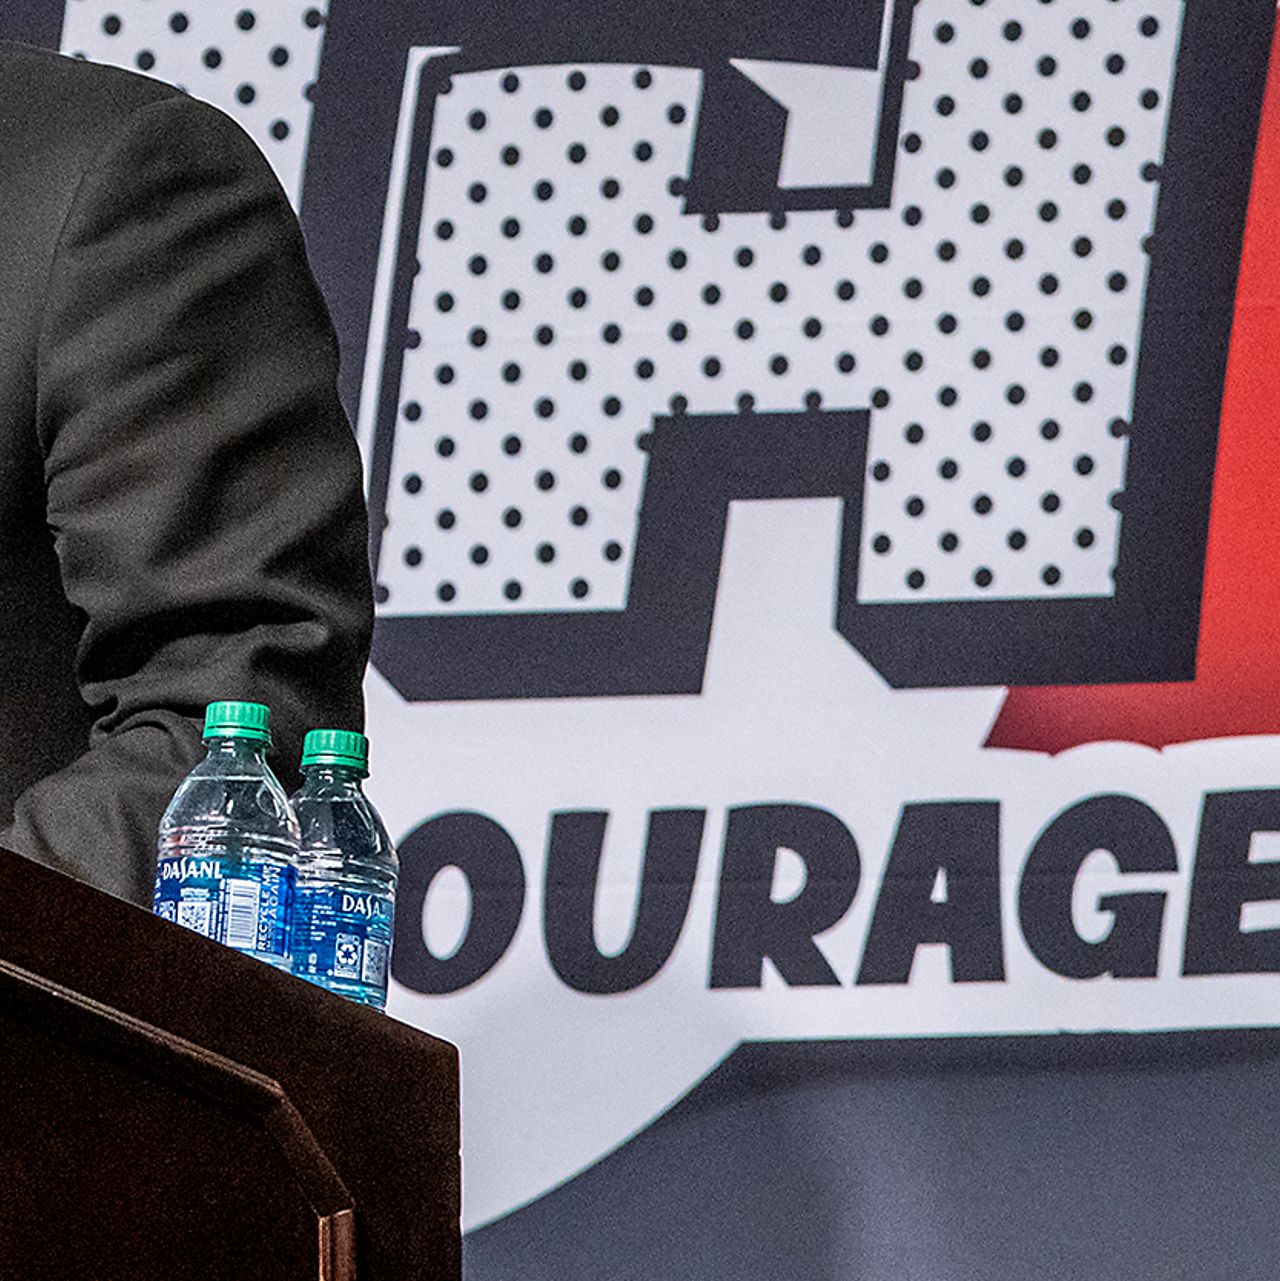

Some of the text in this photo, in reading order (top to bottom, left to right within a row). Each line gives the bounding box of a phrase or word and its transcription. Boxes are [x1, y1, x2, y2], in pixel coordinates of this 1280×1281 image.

[162, 856, 223, 884] DASANI
[391, 789, 1280, 996] OURAGE
[257, 889, 271, 951] RECYCLE
[342, 894, 381, 920] DASA
